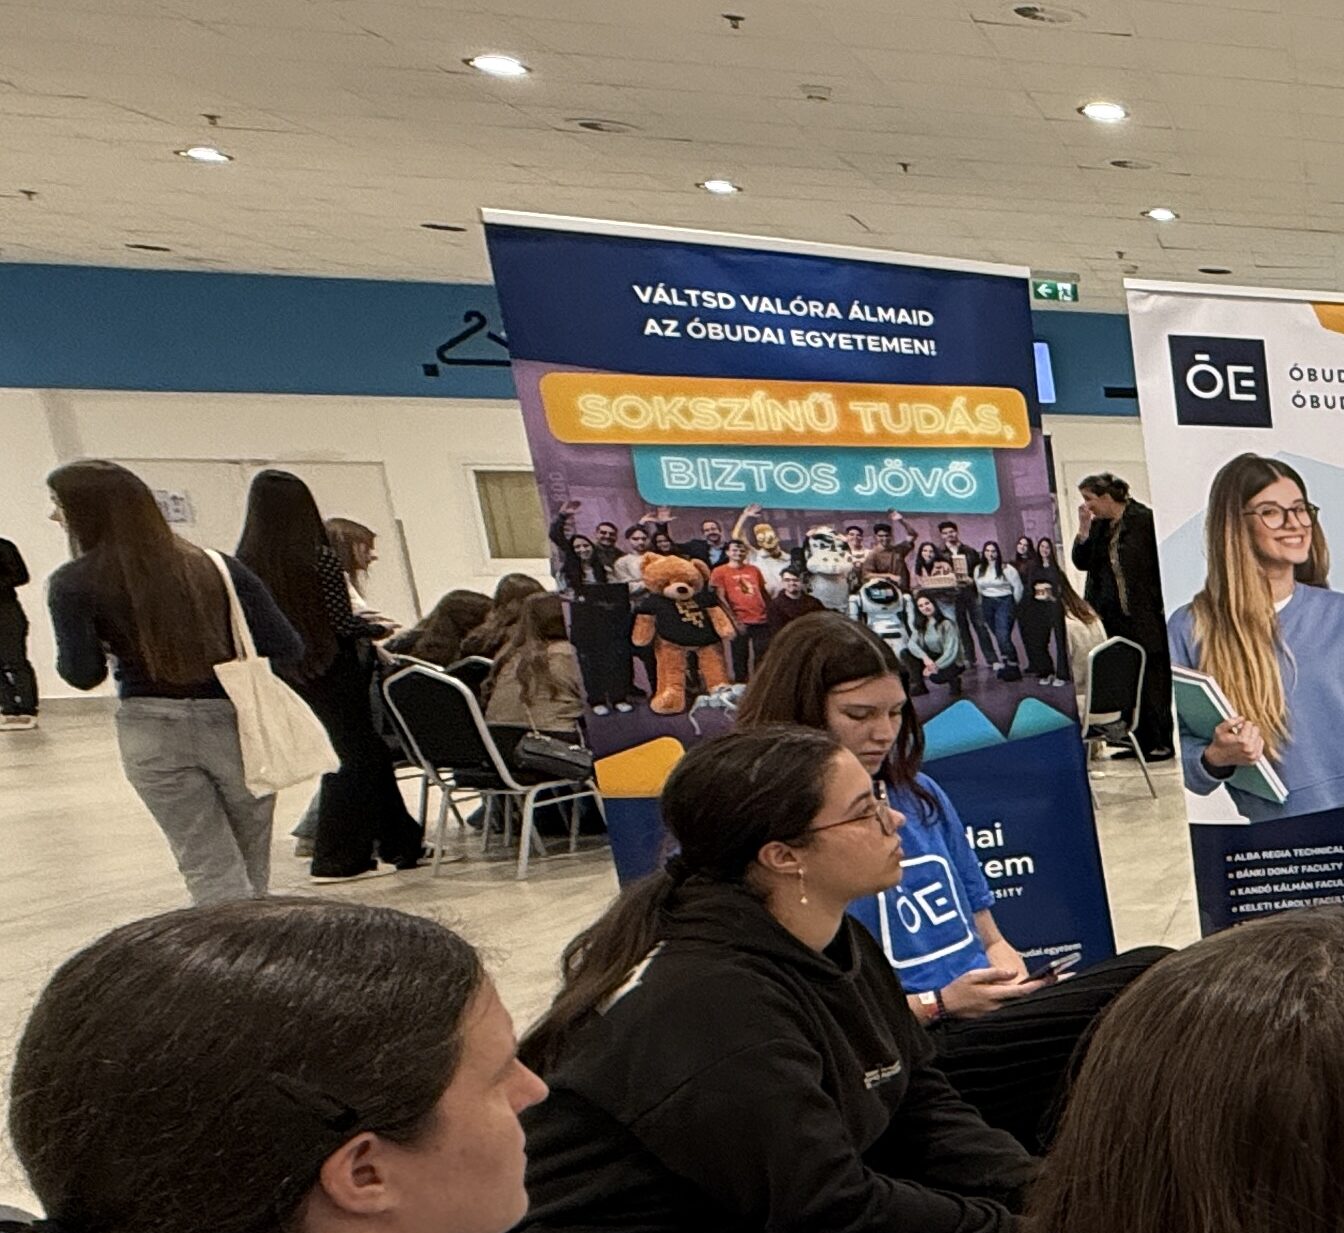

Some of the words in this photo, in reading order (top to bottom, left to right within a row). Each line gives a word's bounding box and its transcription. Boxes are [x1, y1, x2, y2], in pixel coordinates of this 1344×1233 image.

[632, 284, 736, 309] VÁLTSD
[740, 295, 843, 319] VALÓRA
[848, 300, 934, 327] ÁLMAID
[644, 319, 682, 338] AZ
[687, 317, 785, 345] ÓBUDAI
[790, 329, 938, 356] EGYETEMEN!
[577, 389, 840, 433] SOKSZÍNŰ
[850, 396, 1016, 441] TUDÁS,
[660, 456, 840, 493] BIZTOS
[854, 459, 977, 499] JÖVŐ
[1293, 845, 1344, 858] TECHNICAL
[1301, 861, 1343, 874] FACULTY
